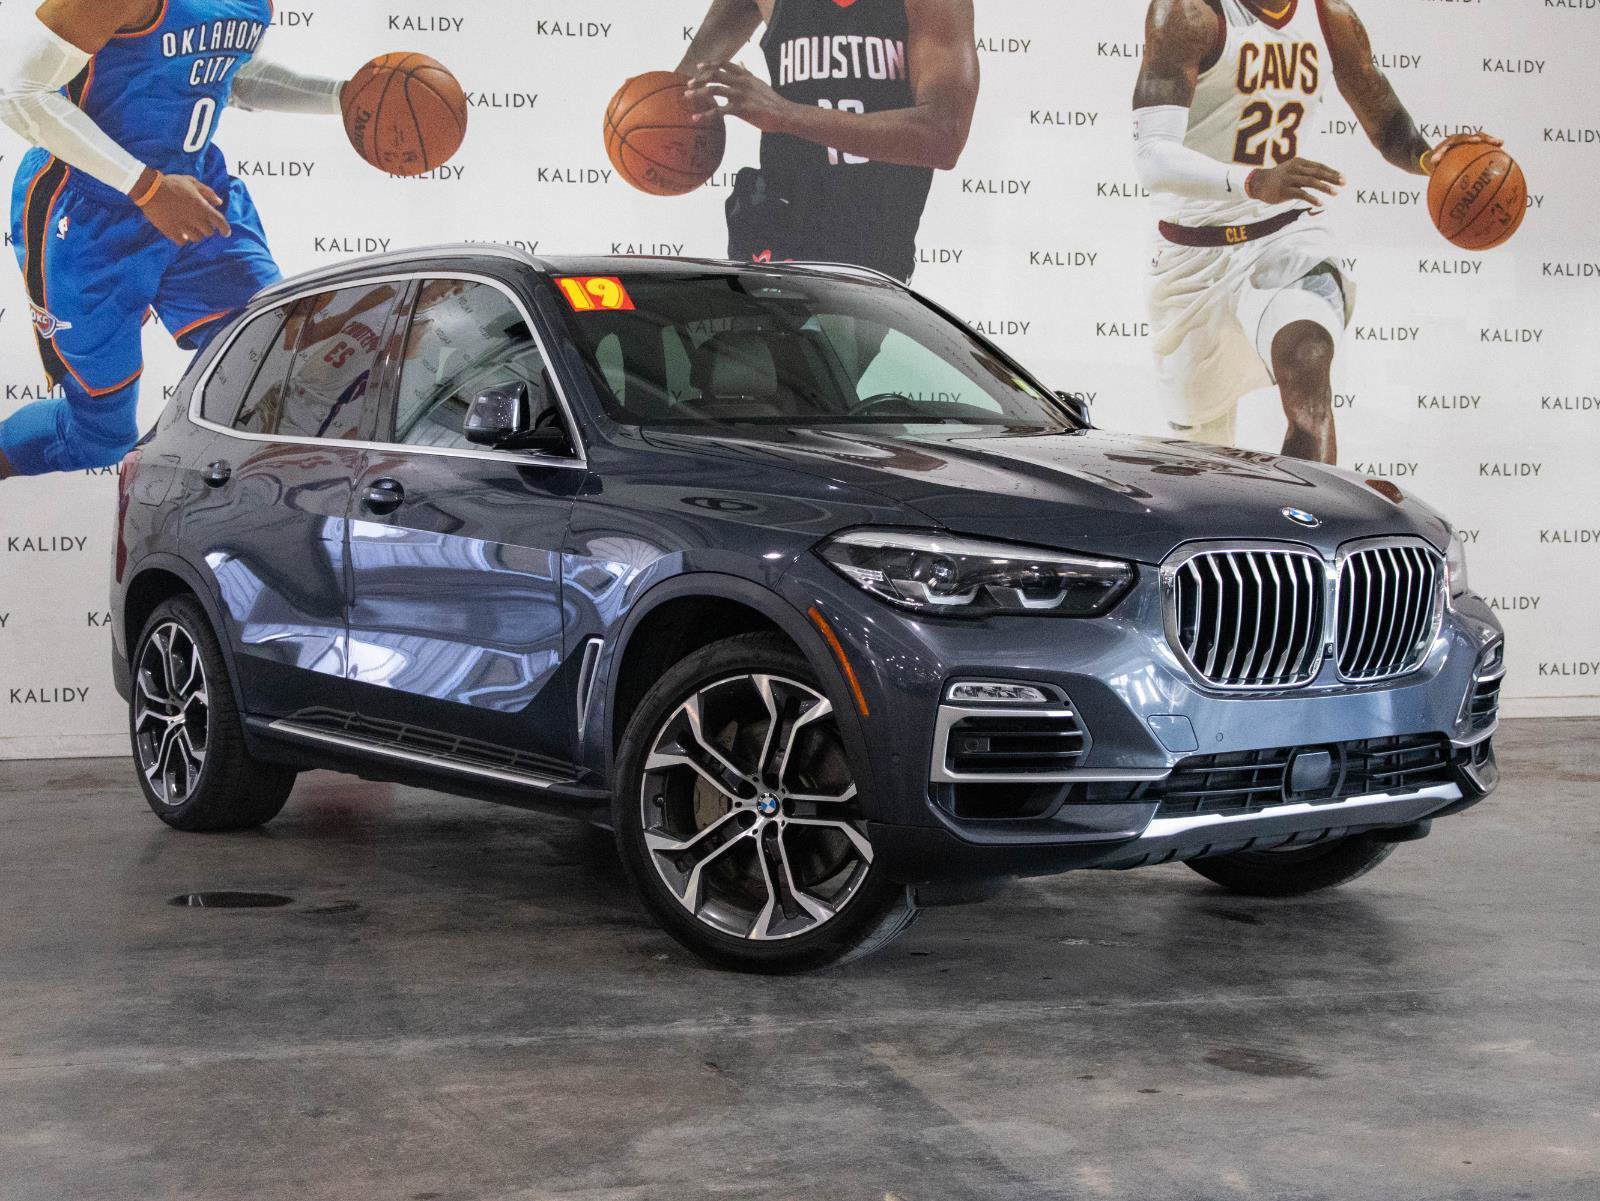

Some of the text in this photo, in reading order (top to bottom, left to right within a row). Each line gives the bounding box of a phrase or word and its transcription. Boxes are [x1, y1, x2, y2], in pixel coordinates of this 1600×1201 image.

[389, 16, 463, 32] KALIDY
[537, 21, 611, 37] KALIDY
[163, 20, 263, 58] OKLAHOM
[975, 39, 1031, 53] ALIDY
[1098, 43, 1146, 57] KALI
[779, 35, 905, 86] HOUSTON
[1372, 55, 1421, 69] ALIDY
[1483, 59, 1545, 73] KALIDY
[189, 56, 235, 86] CITY
[1236, 42, 1319, 95] CAVS
[465, 92, 538, 108] KALIDY
[183, 97, 216, 153] 0
[1030, 110, 1098, 126] KALIDY
[1232, 101, 1305, 166] 23
[1321, 121, 1358, 135] IDY
[238, 161, 314, 176] KALIDY
[538, 168, 611, 183] KALIDY
[963, 179, 1031, 194] KALIDY
[1097, 183, 1149, 197] KALI
[1357, 190, 1420, 204] KALIDY
[1226, 225, 1248, 243] CLE
[315, 237, 390, 252] KALIDY
[913, 250, 963, 263] LIDY
[1030, 251, 1097, 266] KALIDY
[1419, 260, 1482, 274] KALIDY
[560, 277, 624, 309] 19
[1096, 322, 1148, 337] KALID
[1355, 327, 1419, 341] KALIDY
[1481, 329, 1543, 342] KALIDY
[1418, 396, 1480, 409] KALIDY
[1355, 463, 1418, 477] KALIDY
[1480, 463, 1541, 476] KALIDY
[1540, 530, 1600, 543] KALIDY
[8, 537, 87, 552] KALIDY
[1539, 662, 1600, 676] KALIDY
[10, 687, 89, 703] KALIDY
